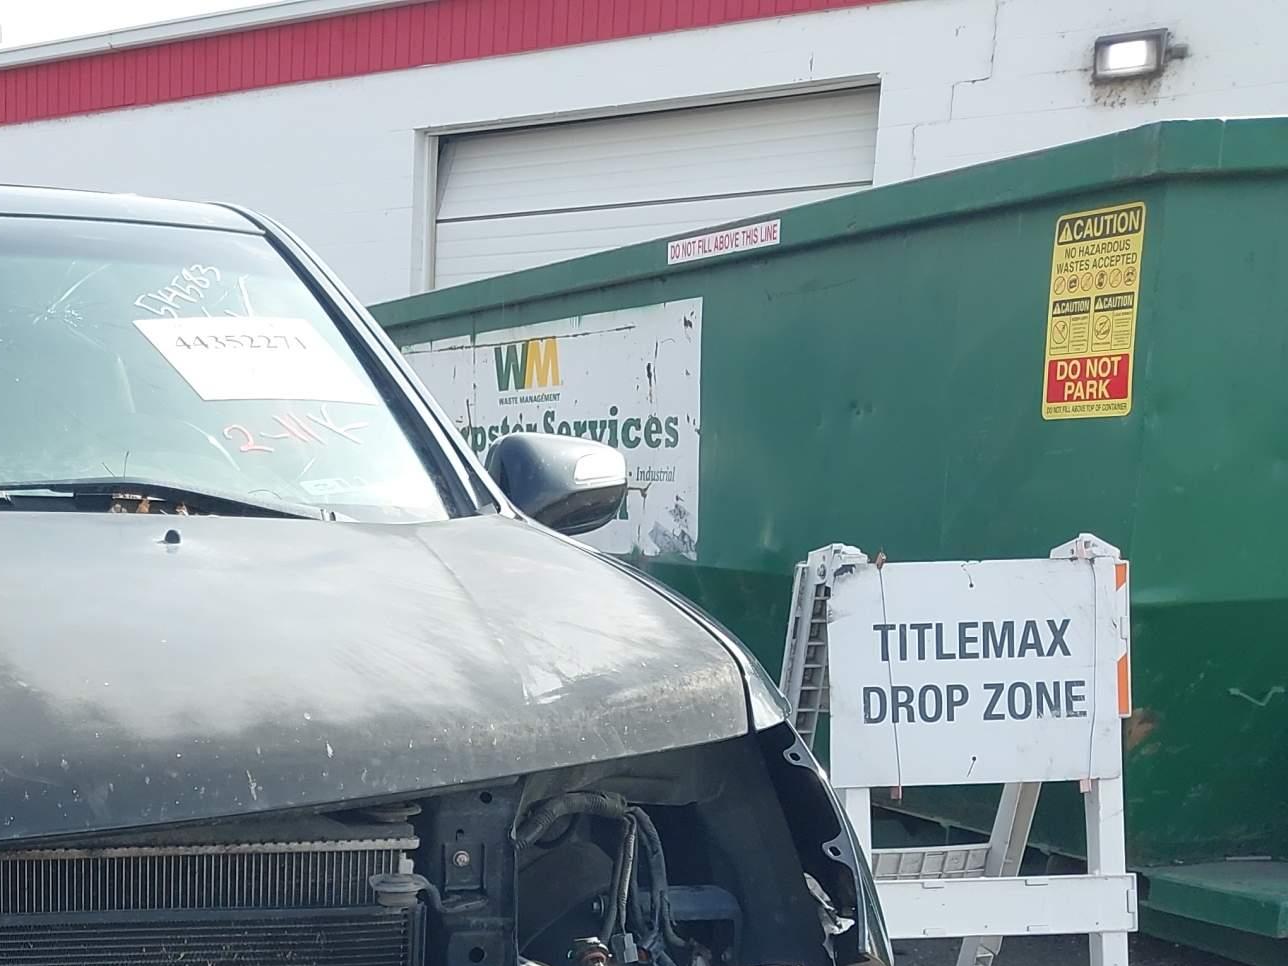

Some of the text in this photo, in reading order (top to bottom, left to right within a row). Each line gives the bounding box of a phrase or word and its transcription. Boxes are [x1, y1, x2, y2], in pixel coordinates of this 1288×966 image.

[1073, 209, 1140, 240] CAUTION
[670, 224, 778, 259] DO NOT FILL ABOVE THIS LINE
[1064, 239, 1131, 259] NO HAZARDOUS
[1056, 252, 1138, 275] WASTES ACCEPTED
[1061, 300, 1090, 313] CAUTION
[1103, 294, 1134, 308] CAUTION
[175, 335, 308, 350] 44352271
[494, 336, 561, 391] WM
[1056, 356, 1122, 380] DO NOT
[499, 393, 561, 406] WASTE MANAGEMENT
[1064, 379, 1110, 401] PARK
[543, 406, 680, 449] Services
[636, 466, 676, 482] Industrial
[872, 619, 1072, 662] TITLEMAX
[863, 680, 1087, 724] DROP ZONE
